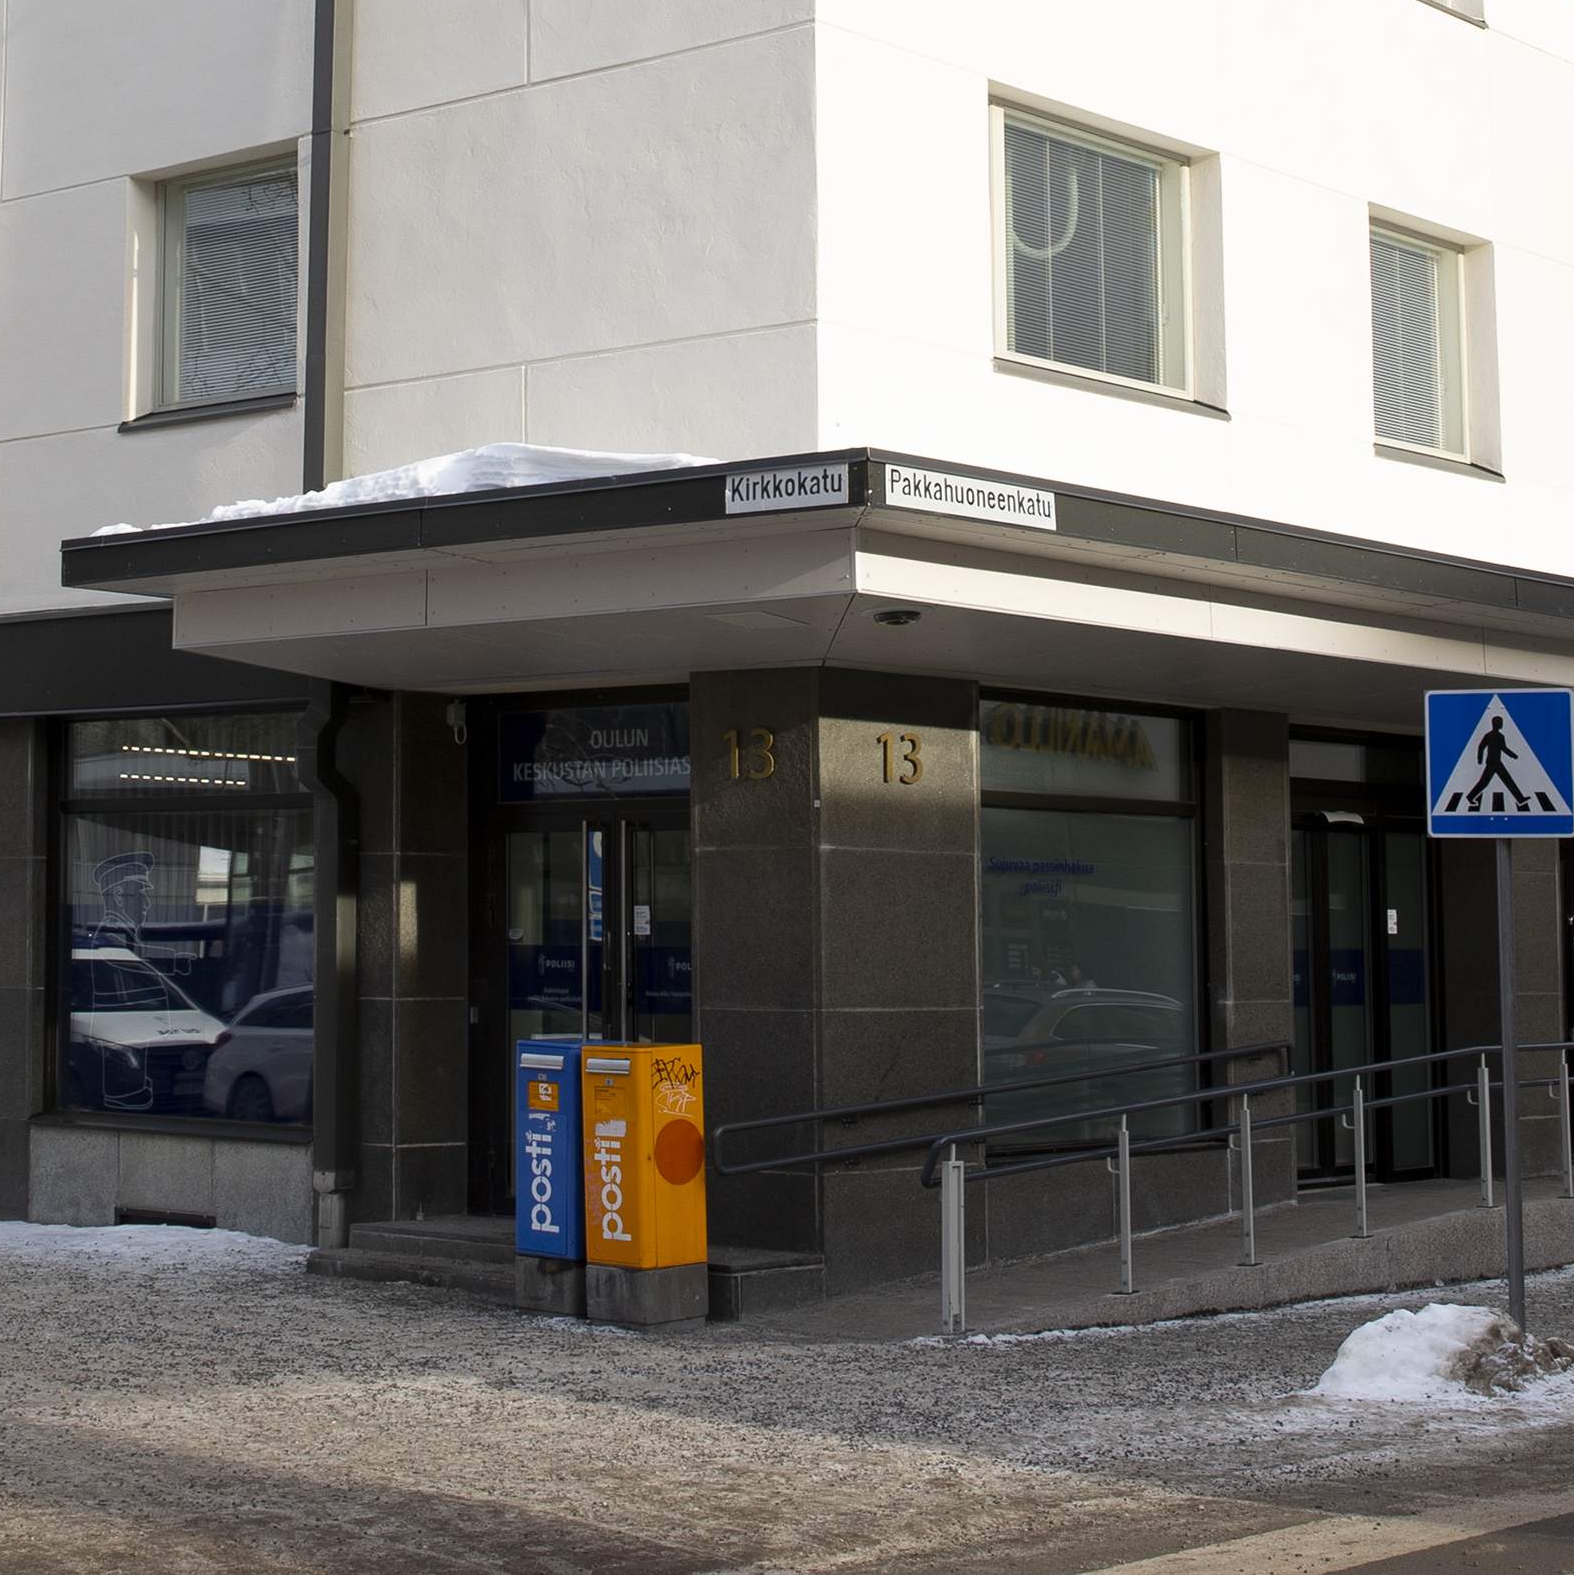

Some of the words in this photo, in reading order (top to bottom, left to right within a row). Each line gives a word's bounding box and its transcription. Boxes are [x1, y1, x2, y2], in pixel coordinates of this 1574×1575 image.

[730, 468, 843, 504] Kirkkokatu
[889, 468, 1052, 519] Pakkahuoneenkatu
[590, 727, 649, 749] OULUN
[723, 728, 776, 781] 13
[876, 732, 925, 786] 13
[513, 759, 607, 782] KESKUSTAN
[989, 856, 1031, 875] Sujuvaa
[1032, 859, 1094, 875] passinhakua
[545, 959, 575, 969] POLIISI
[525, 1131, 560, 1234] posti
[594, 1138, 632, 1242] posti
